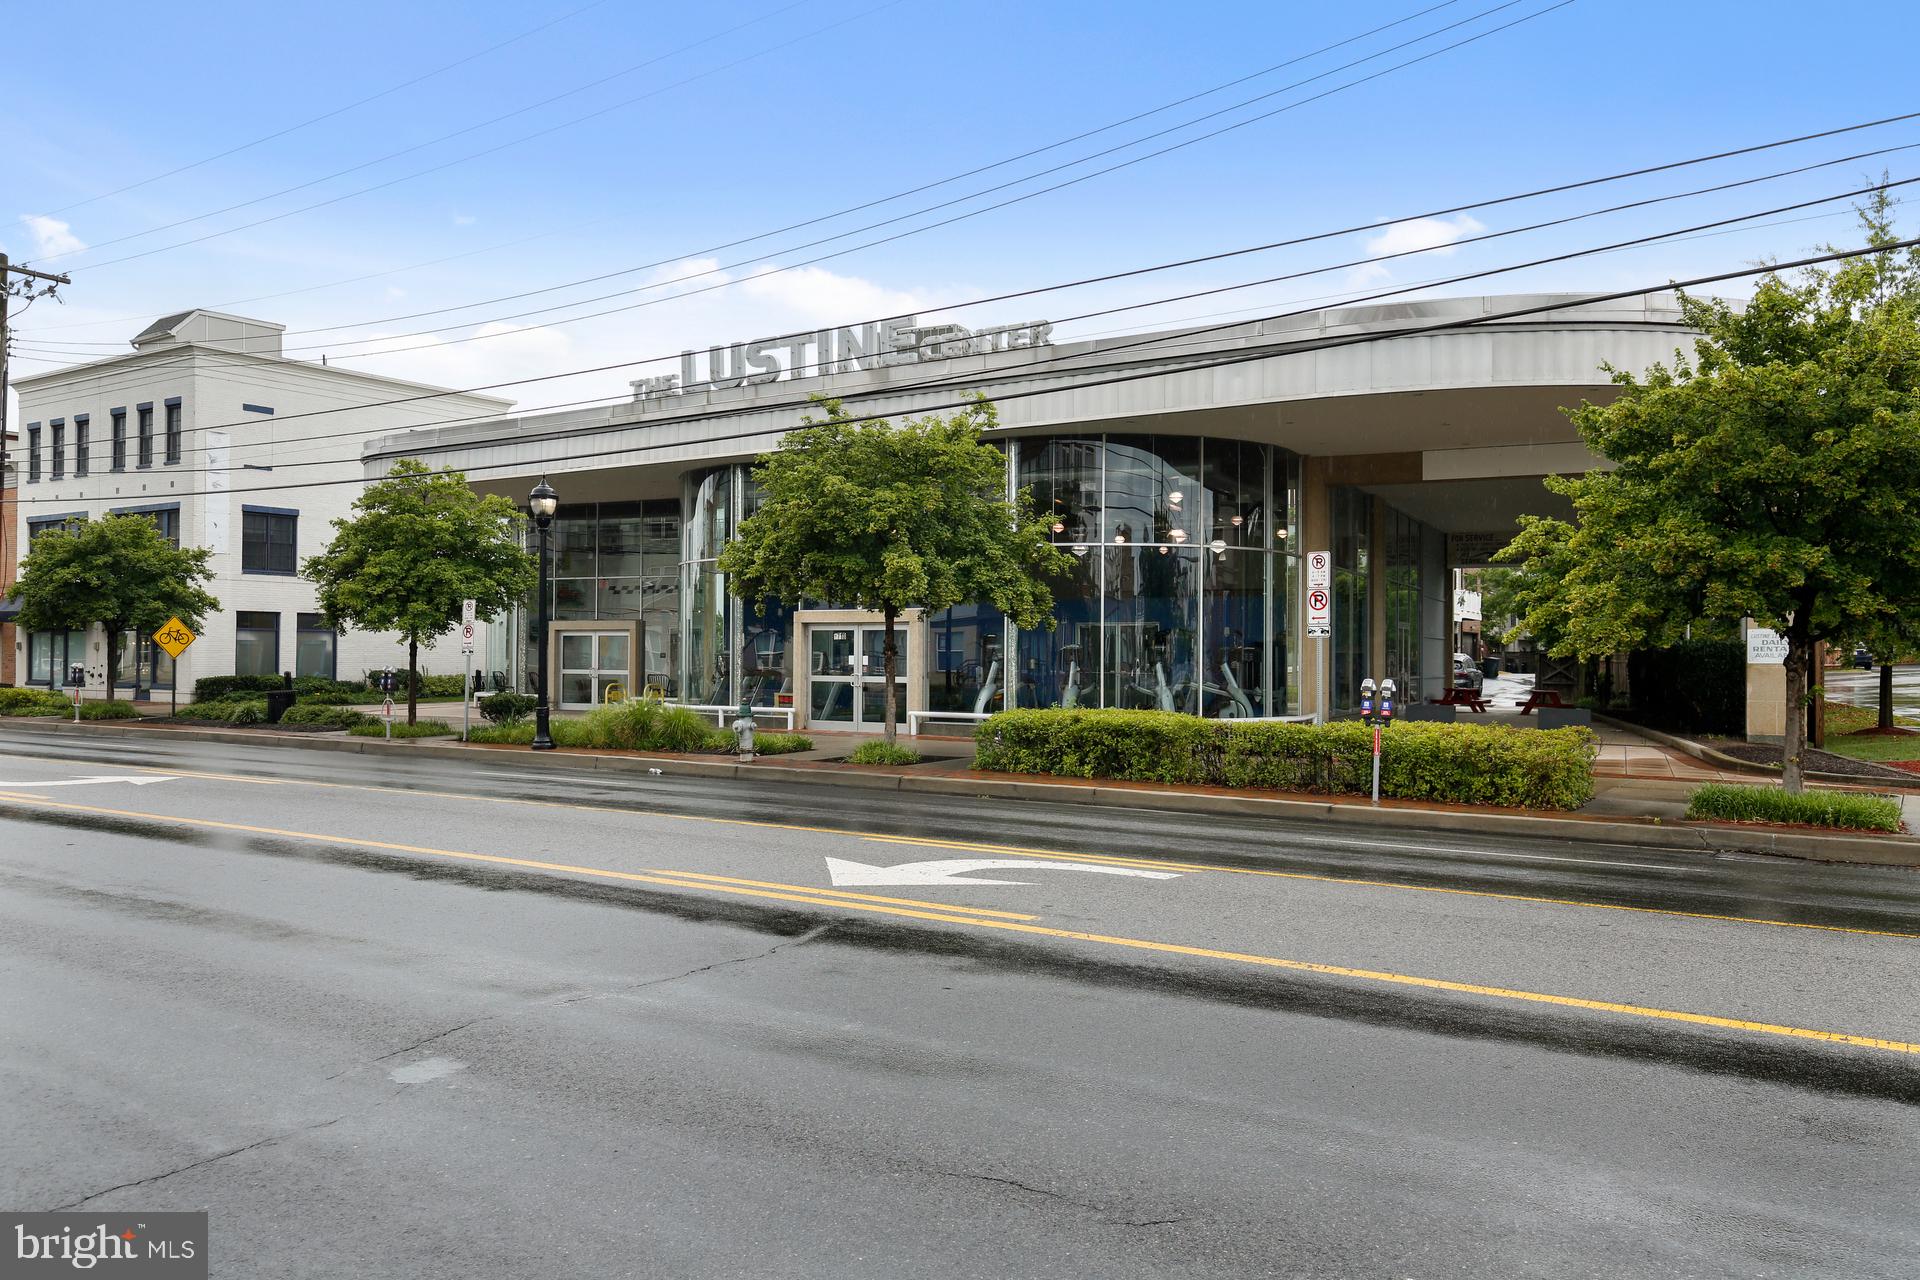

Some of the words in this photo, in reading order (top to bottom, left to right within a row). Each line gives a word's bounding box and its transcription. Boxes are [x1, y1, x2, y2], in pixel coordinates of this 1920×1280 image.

[629, 373, 680, 402] THE
[681, 315, 918, 395] LUSTINE
[919, 319, 1054, 362] CENTER
